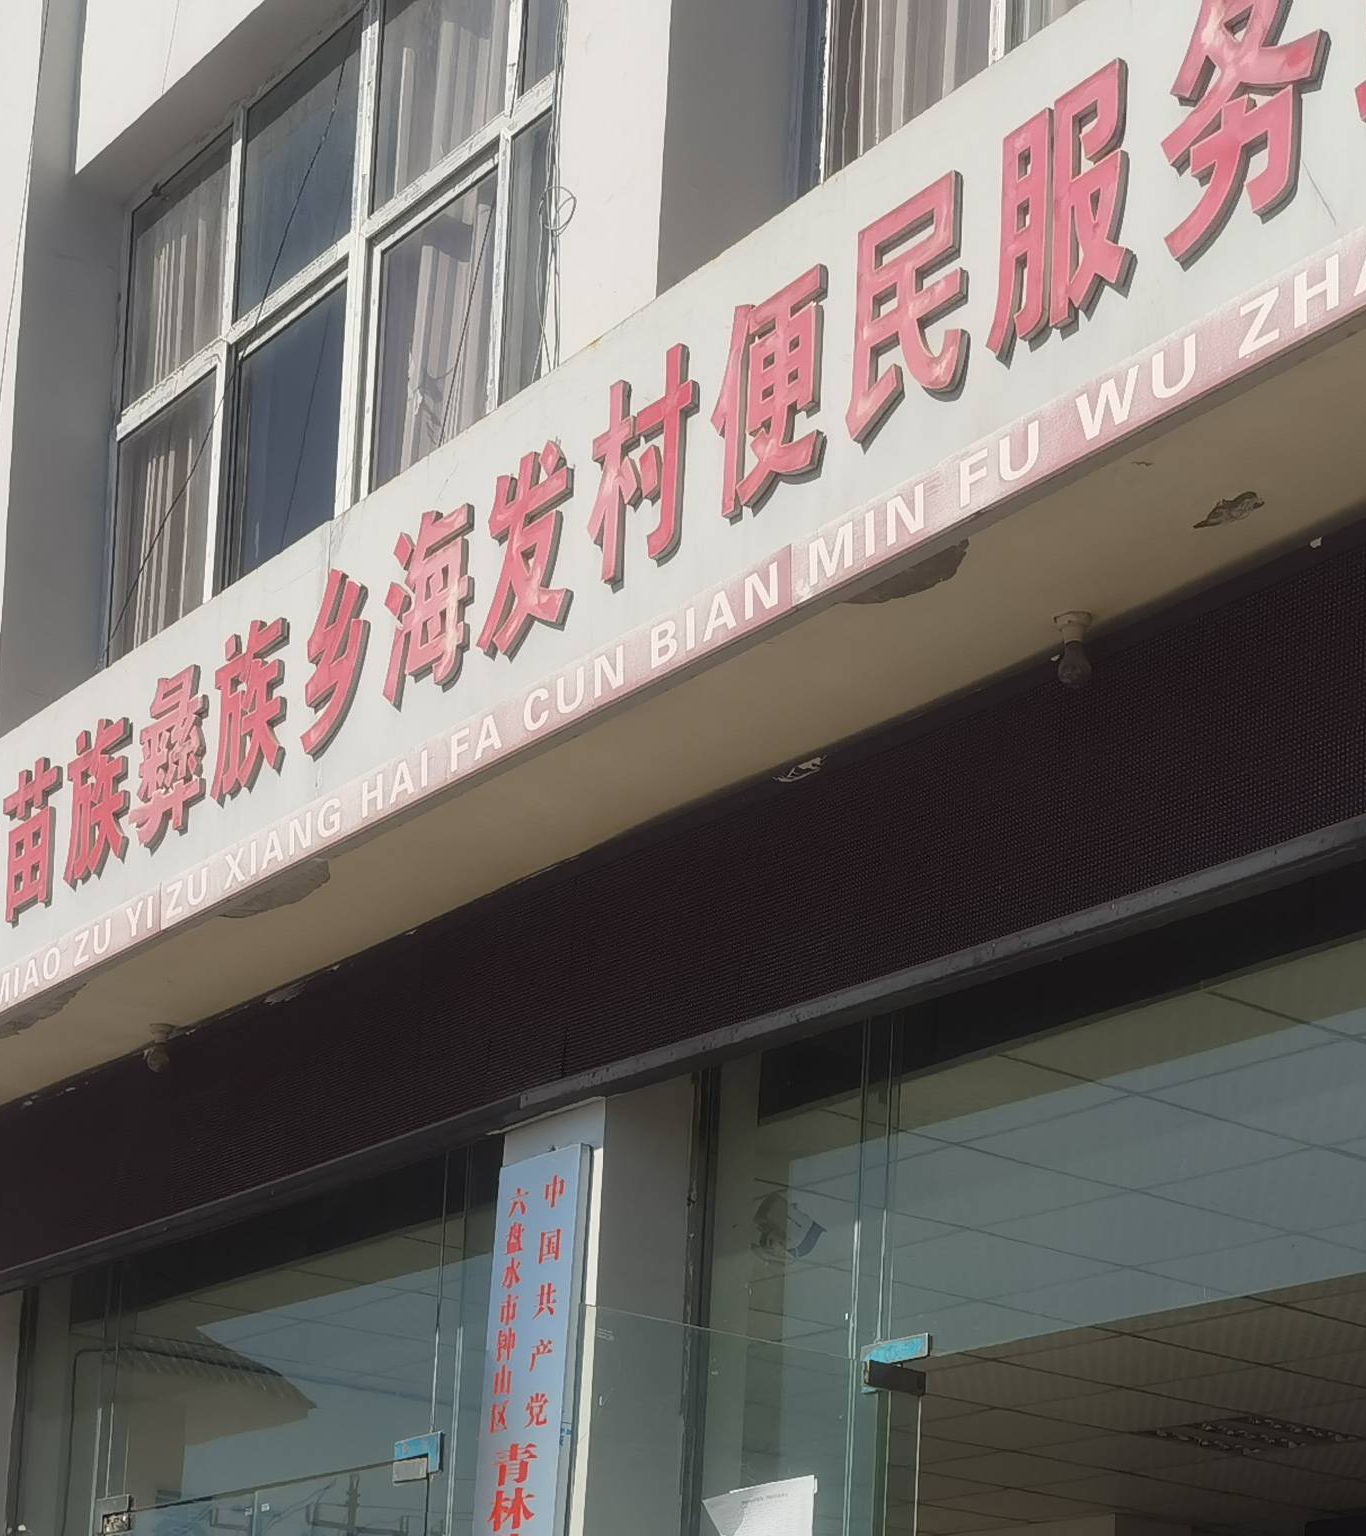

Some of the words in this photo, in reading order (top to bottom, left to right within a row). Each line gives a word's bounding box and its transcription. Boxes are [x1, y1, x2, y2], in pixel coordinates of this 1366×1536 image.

[73, 918, 112, 967] ZU
[125, 896, 155, 933] YI
[165, 871, 209, 922] ZU
[224, 803, 341, 891] XIANG
[362, 752, 429, 815] HAI
[448, 712, 502, 772] FA
[522, 648, 624, 733] CUN
[648, 561, 779, 668] BIAN
[807, 487, 927, 587] MIN
[957, 427, 1041, 507] FU
[1073, 335, 1198, 438] WU
[490, 1187, 529, 1434] 六盘水市钟山区
[524, 1174, 566, 1428] 中国共产党
